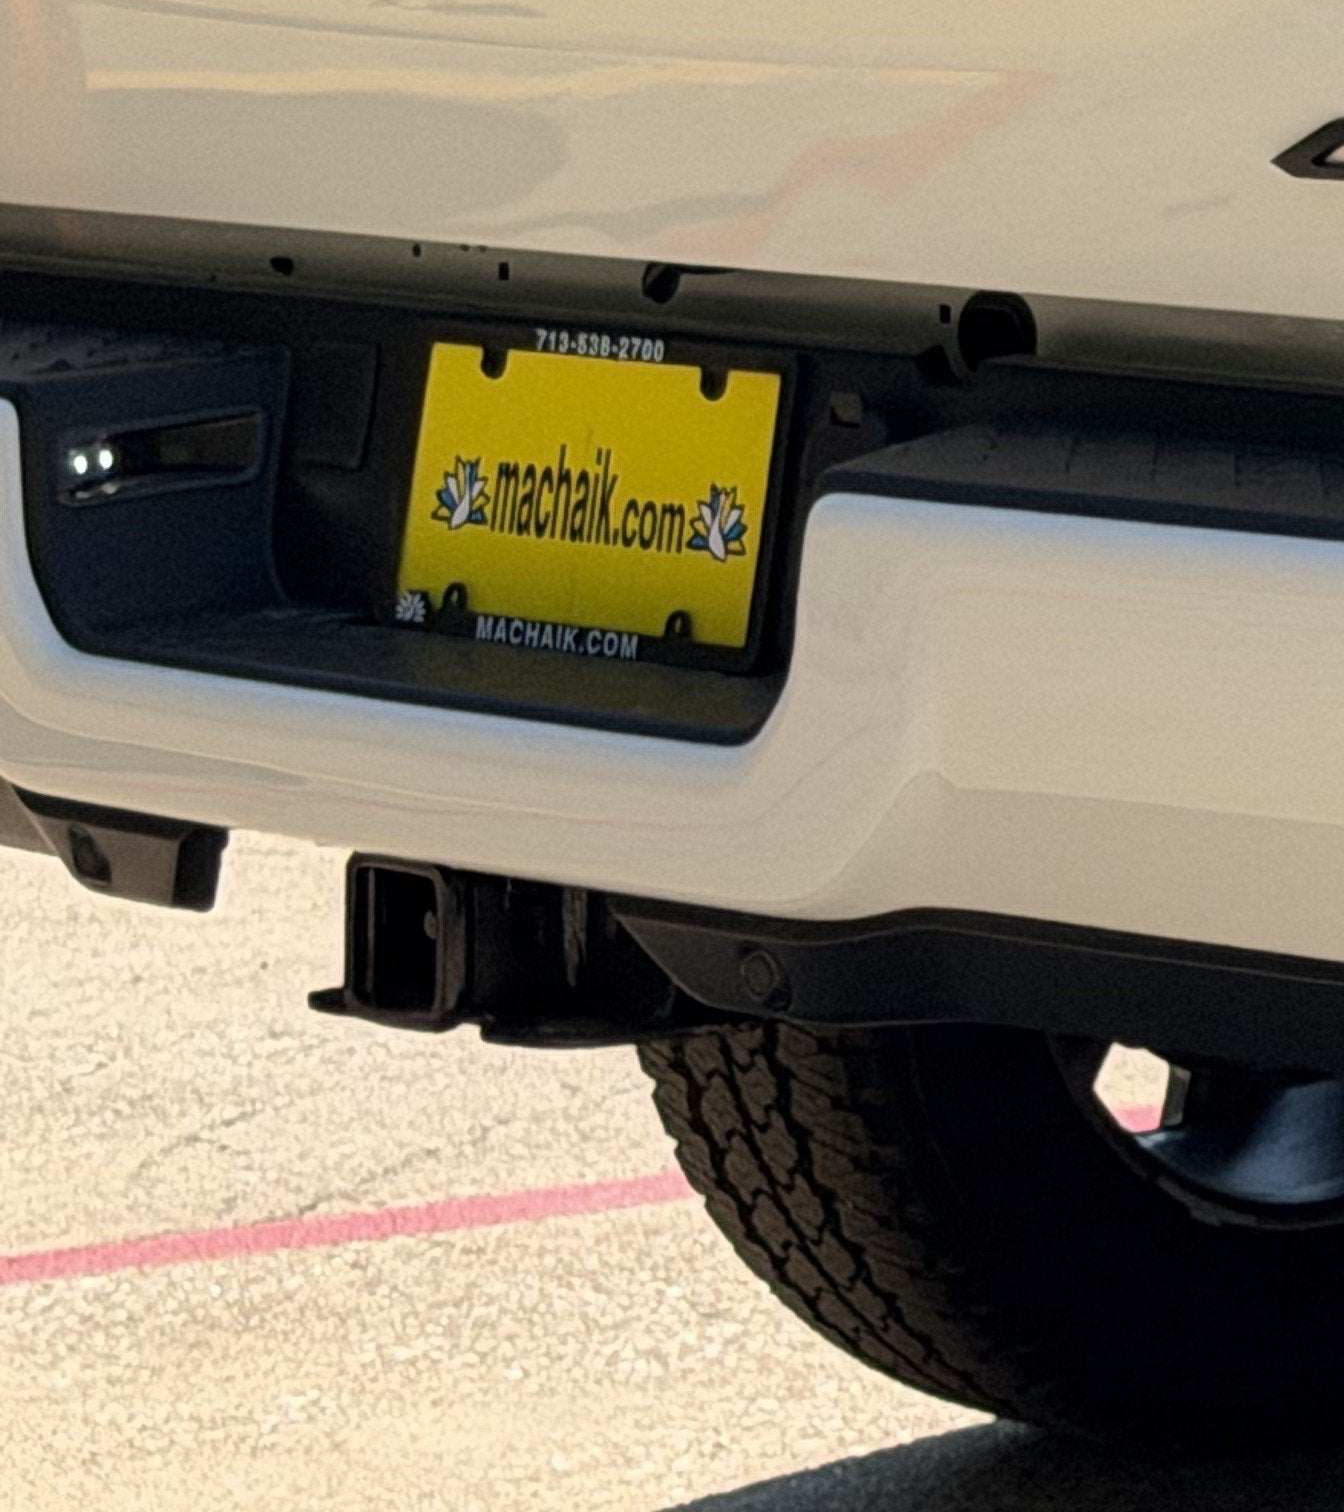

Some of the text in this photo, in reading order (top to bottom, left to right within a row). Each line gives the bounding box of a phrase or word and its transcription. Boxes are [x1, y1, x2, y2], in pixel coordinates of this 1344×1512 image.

[535, 327, 665, 363] 713-538-2700
[489, 443, 686, 554] machaik.com
[475, 615, 639, 660] MACHAIK.COM
